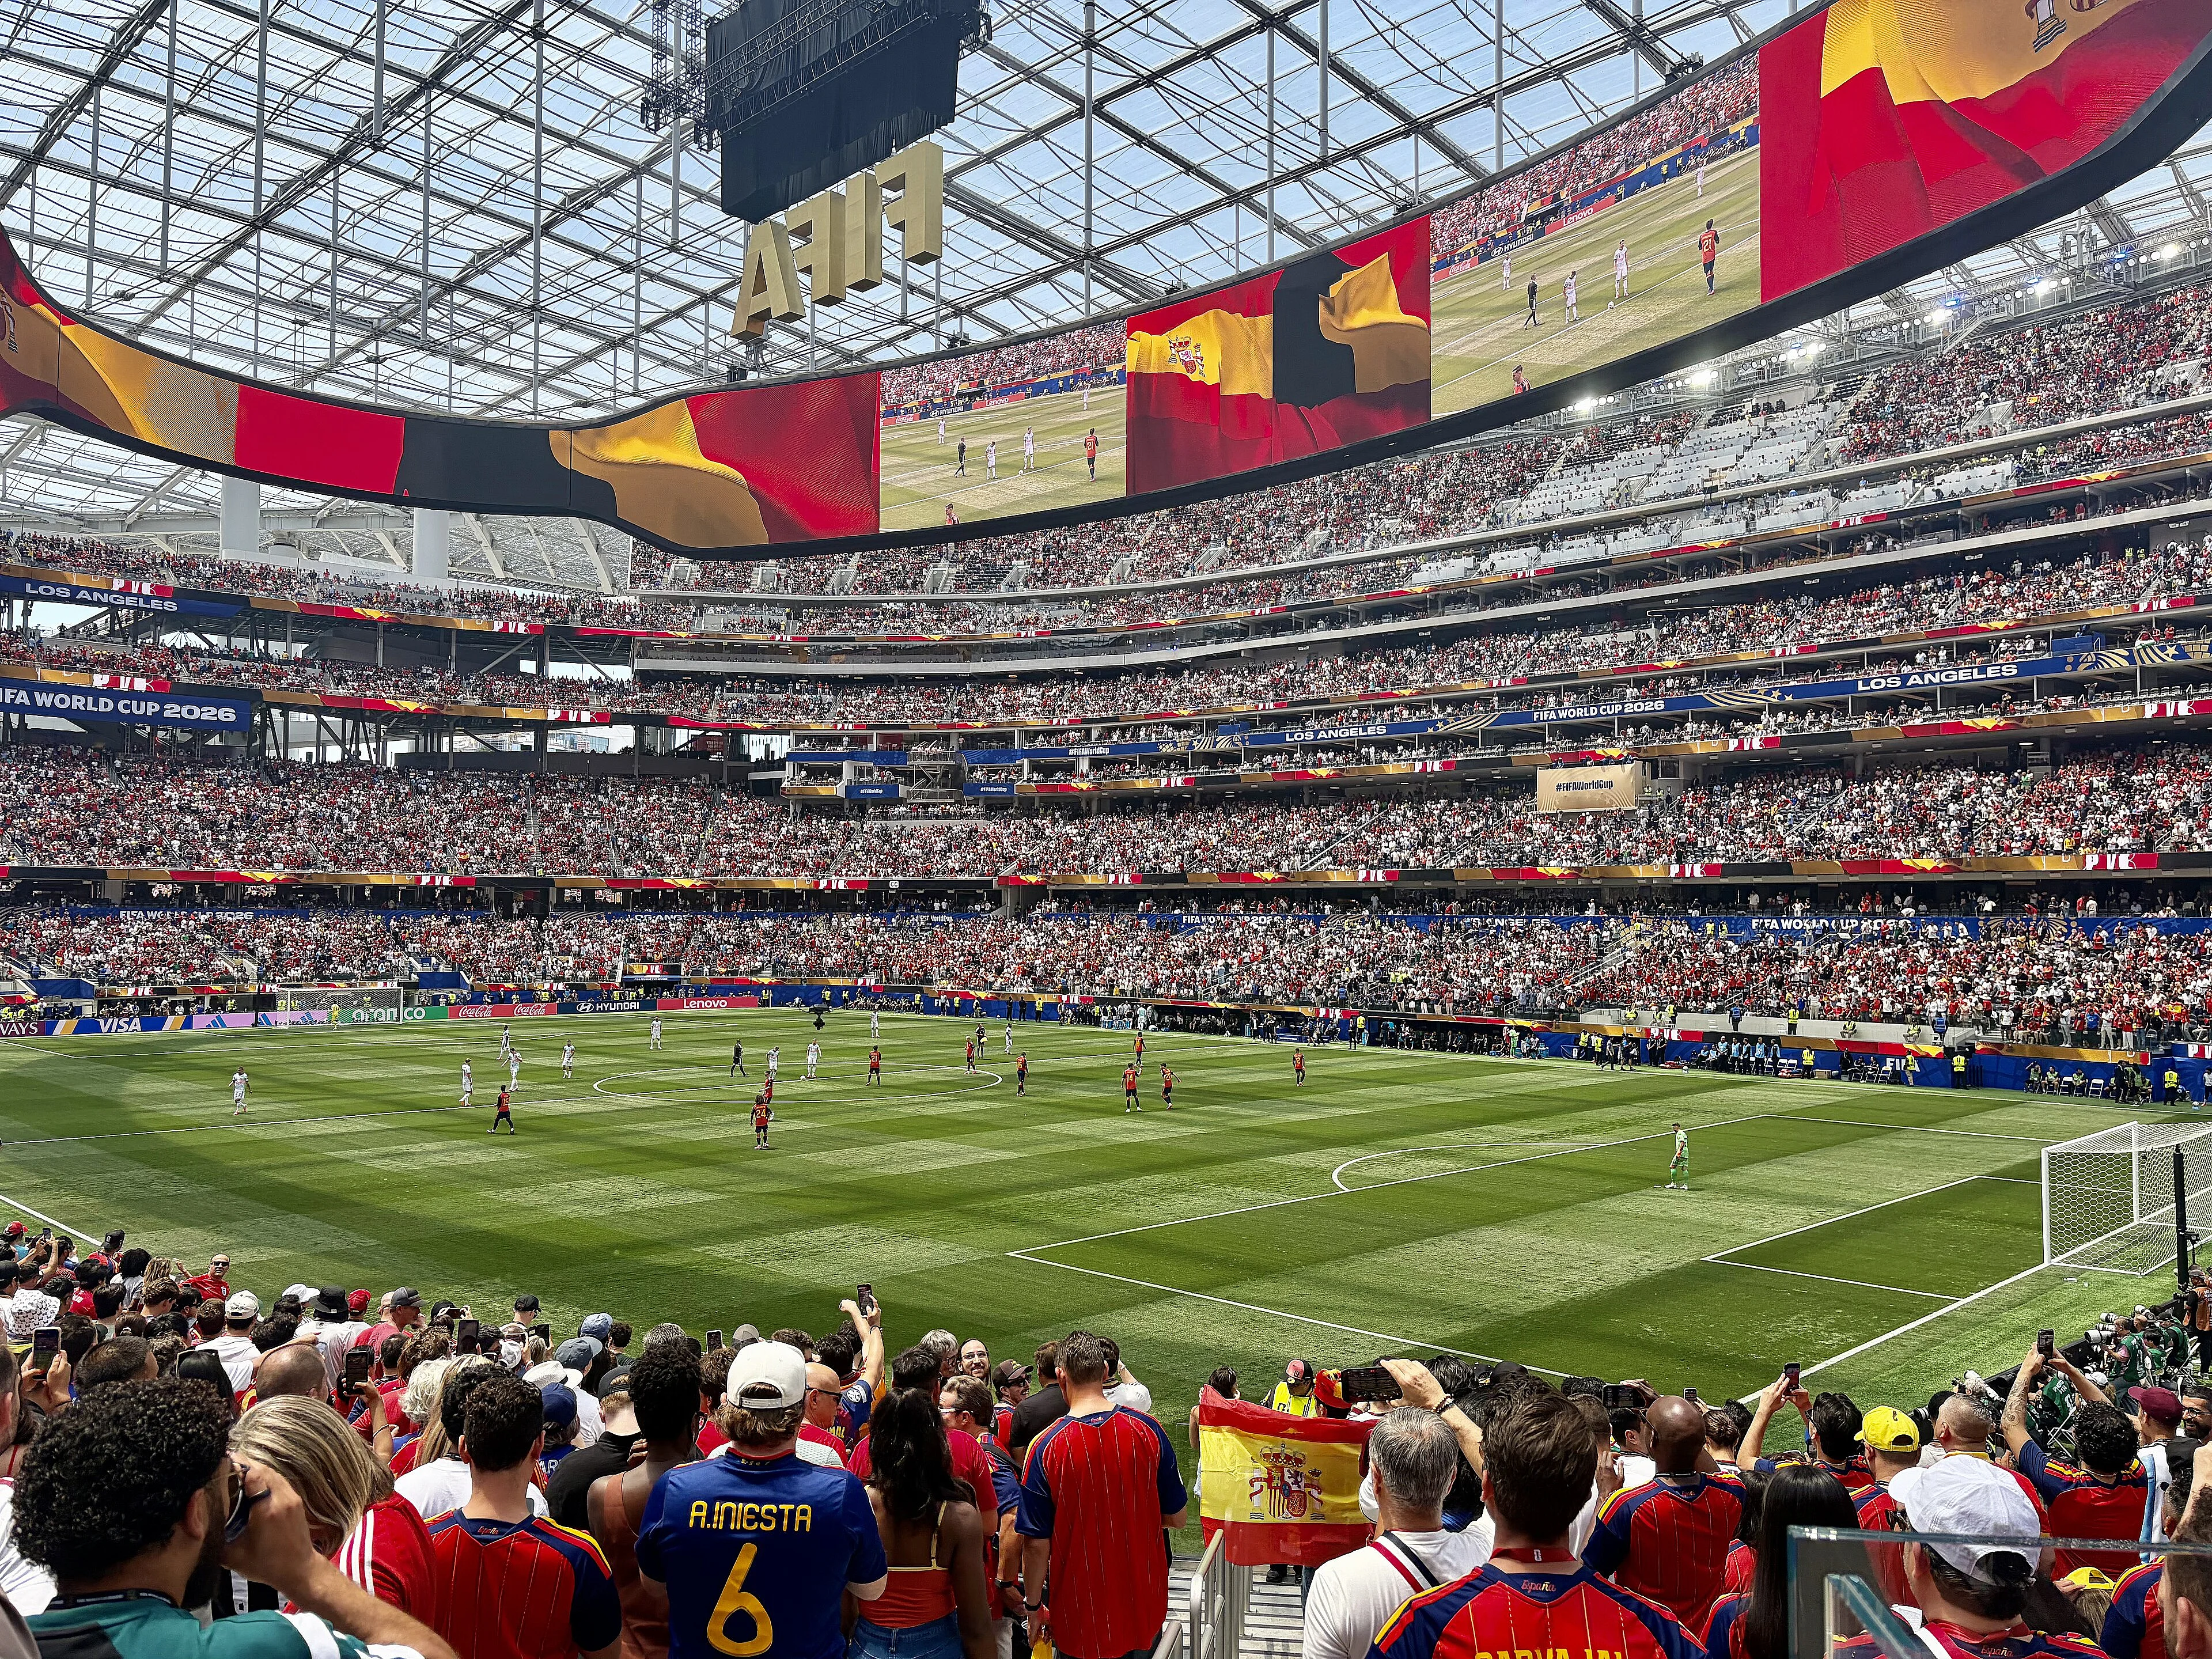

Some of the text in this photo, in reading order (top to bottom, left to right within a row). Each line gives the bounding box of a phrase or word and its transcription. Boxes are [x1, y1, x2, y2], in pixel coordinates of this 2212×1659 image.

[1563, 207, 1593, 226] Lenovo
[1504, 233, 1534, 251] HYUNDAI
[1703, 238, 1712, 252] 21
[1086, 441, 1094, 450] 21
[25, 583, 178, 611] LOS ANGELES
[1858, 664, 2018, 691] LOS ANGELES
[34, 691, 114, 712] WORLD
[118, 699, 160, 715] CUP
[164, 703, 237, 722] 2026
[1533, 700, 1665, 721] FIFA WORLD CUP 2026
[1286, 725, 1387, 741] LOS ANGELES
[1069, 747, 1109, 756] #FIFAWorldCup
[1555, 779, 1613, 792] #FIFAWorldCup
[1183, 915, 1200, 923] FIFA
[1752, 919, 1779, 930] FIFA
[596, 1001, 639, 1011] HYUNDAI
[683, 998, 728, 1009] Lenovo
[934, 999, 950, 1007] FIA
[95, 1017, 142, 1033] VISA
[756, 1109, 766, 1118] 24
[689, 1500, 812, 1532] A.INIESTA
[1521, 1580, 1556, 1593] España
[707, 1542, 772, 1657] 6
